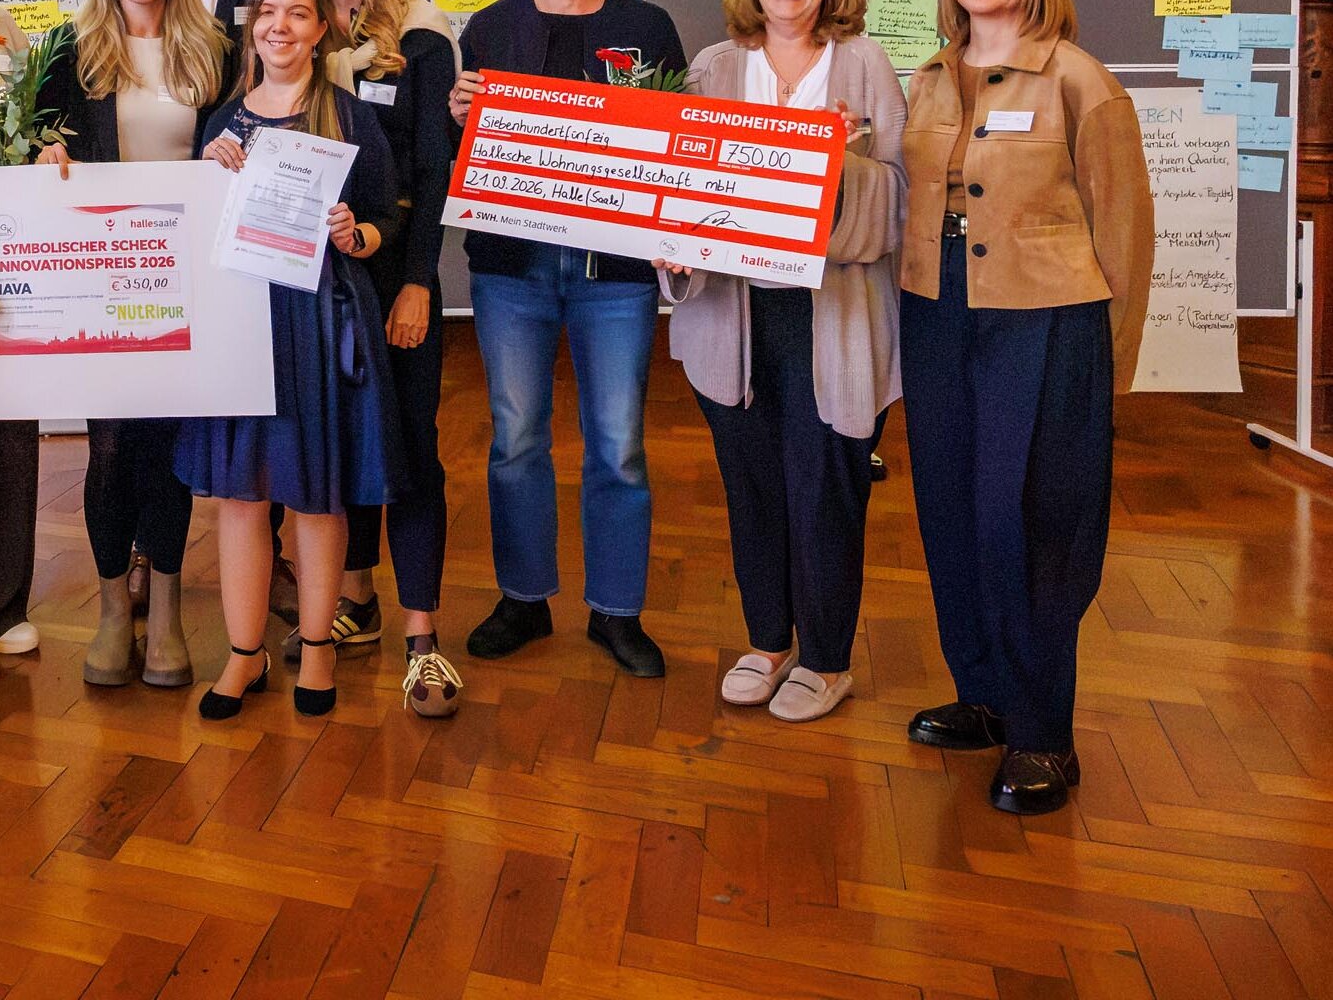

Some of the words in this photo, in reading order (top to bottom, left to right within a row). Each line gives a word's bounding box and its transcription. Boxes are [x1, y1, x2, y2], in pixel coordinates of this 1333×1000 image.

[487, 84, 606, 109] SPENDENSCHECK
[681, 108, 833, 139] GESUNDHEITSPREIS
[681, 139, 707, 154] EUR
[727, 144, 791, 169] 750,00
[279, 161, 312, 175] Urkunde
[472, 142, 532, 164] Hallesche
[539, 150, 692, 192] Wohnungsgesellschaft
[705, 179, 736, 194] mbH
[552, 183, 583, 202] Halle
[585, 191, 624, 212] (Saale)
[130, 218, 177, 229] hallesaale
[475, 211, 498, 223] SWH.
[500, 215, 521, 226] Mein
[523, 219, 568, 234] Stadtwerk
[2, 240, 107, 255] SYMBOLISCHER
[111, 238, 168, 252] SCHECK
[140, 255, 175, 268] 2026
[741, 254, 805, 273] hallesaale
[123, 278, 168, 291] 350,00
